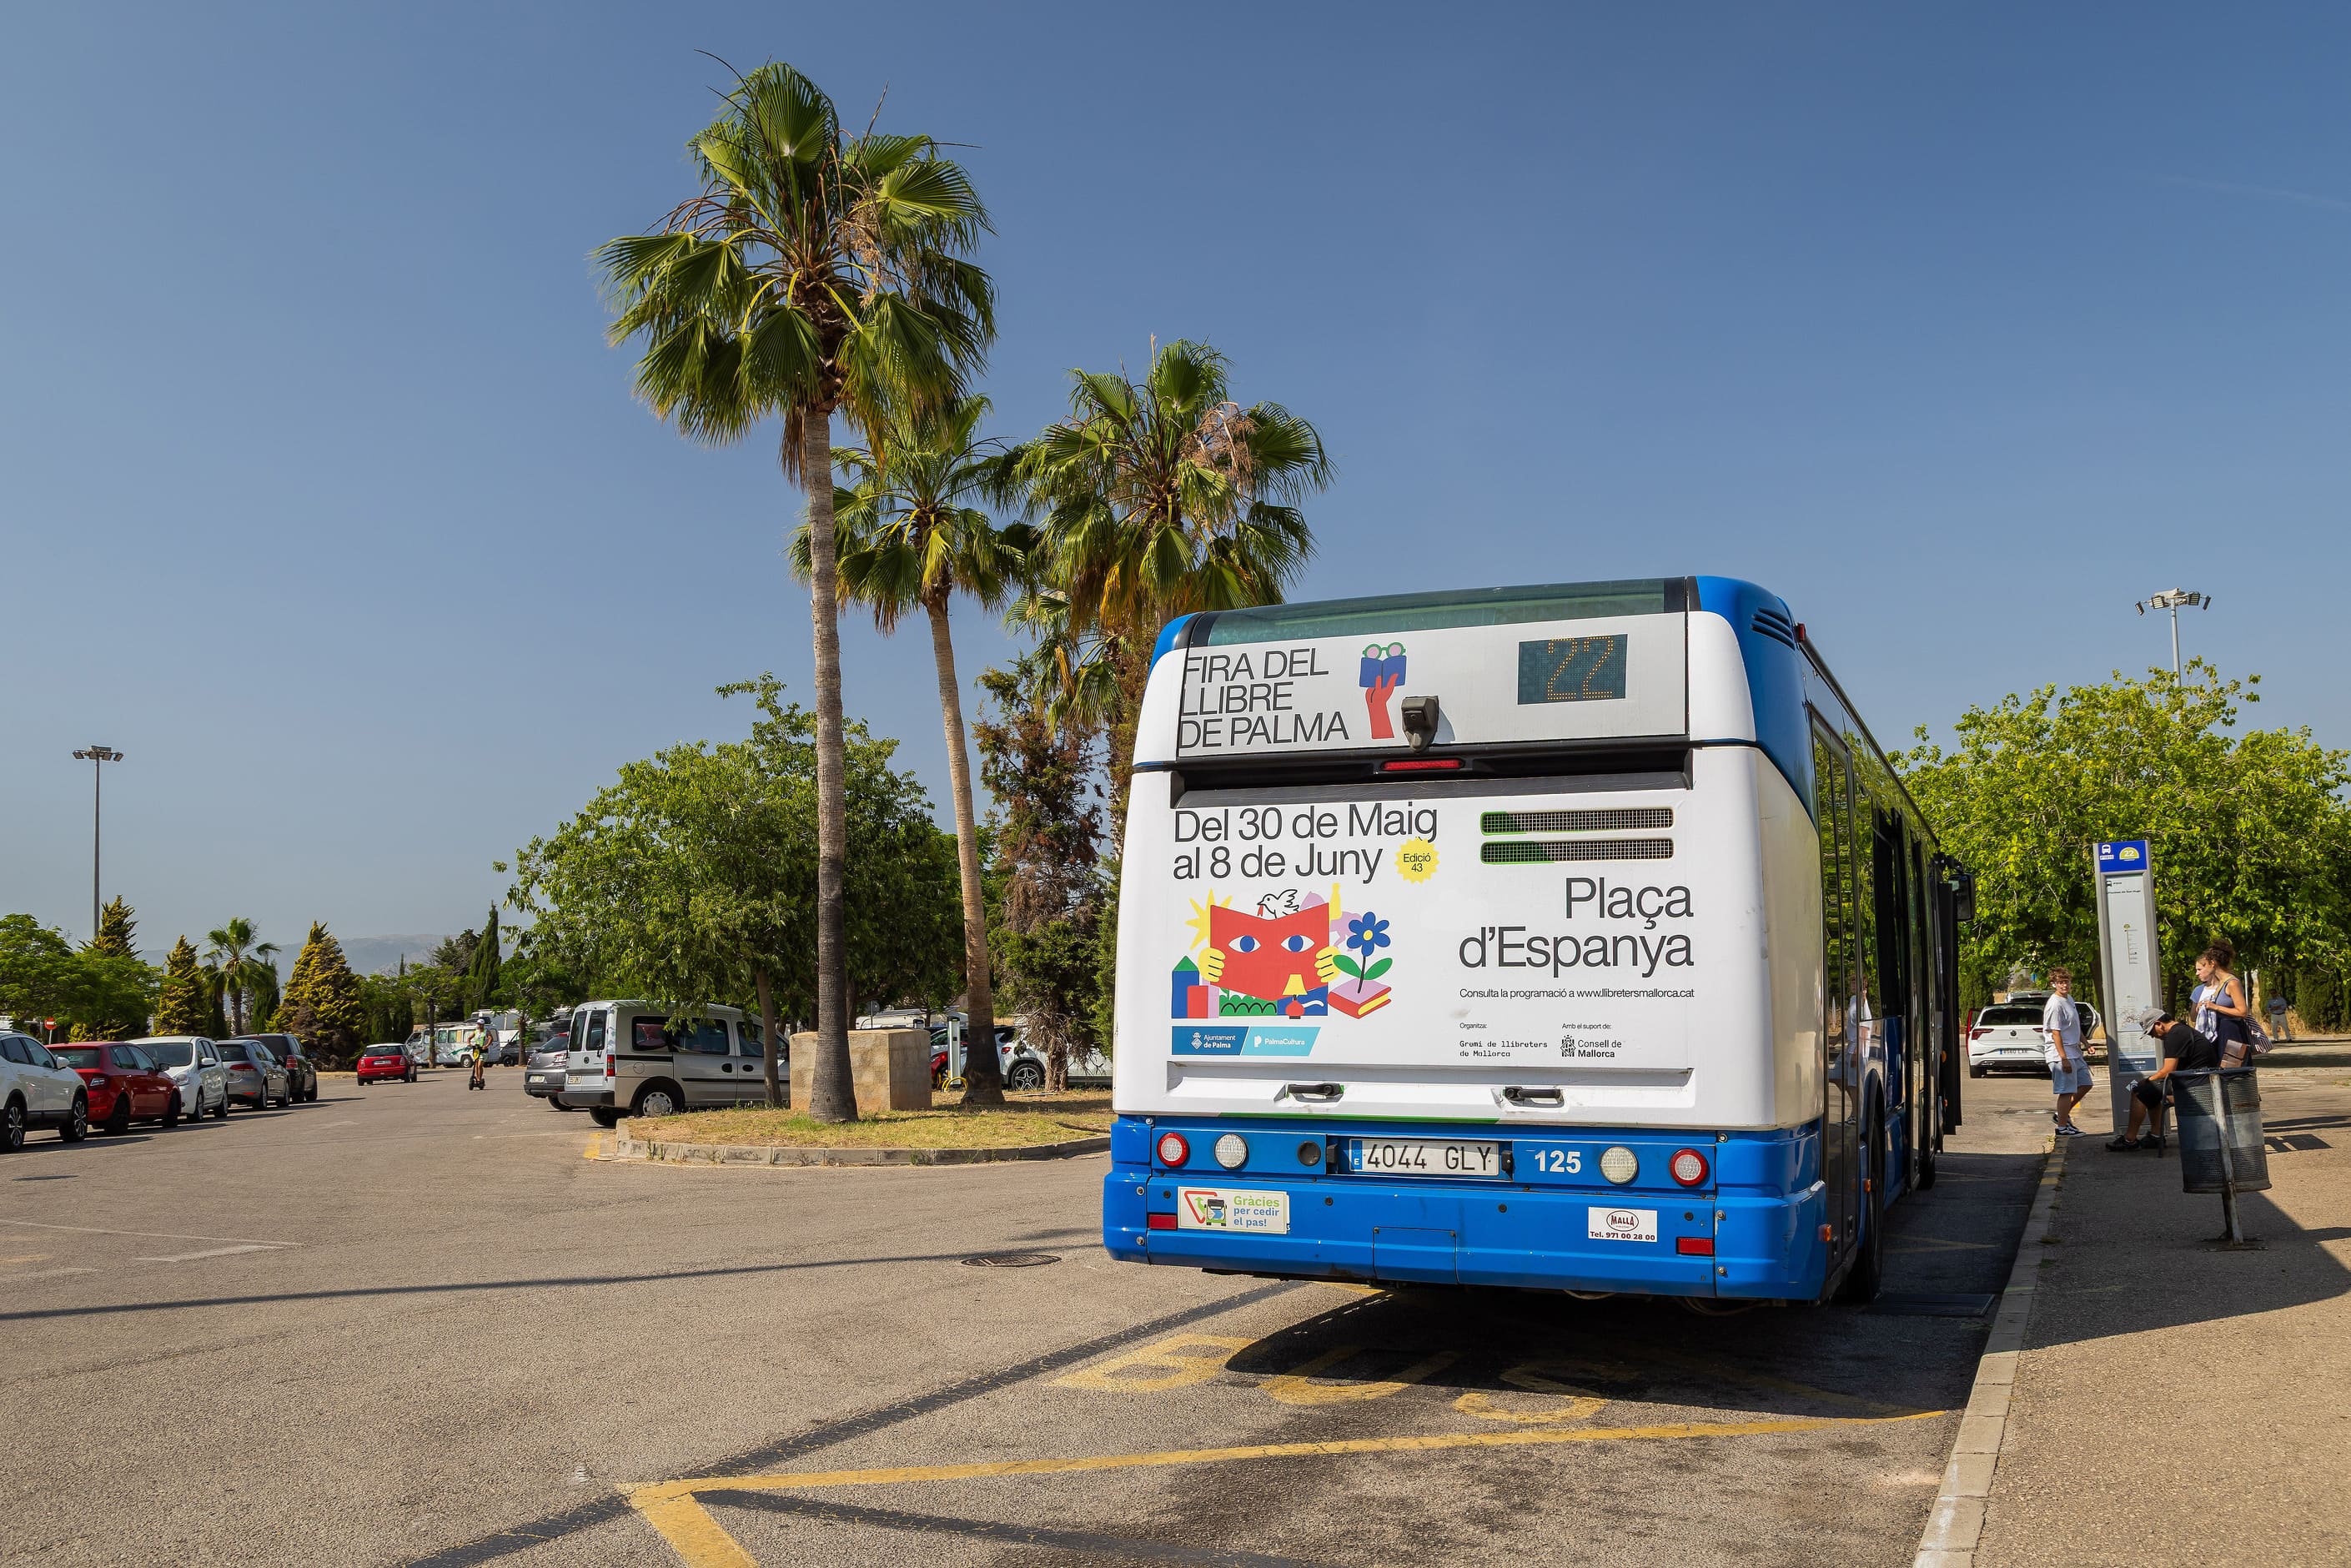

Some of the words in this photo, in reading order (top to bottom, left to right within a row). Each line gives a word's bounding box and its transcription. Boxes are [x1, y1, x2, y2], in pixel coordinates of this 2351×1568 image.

[1186, 653, 1254, 683] FIRA
[1263, 648, 1329, 679] DEL
[1548, 636, 1613, 700] 22
[1181, 681, 1294, 716] LLIBRE
[1178, 718, 1222, 748] DE
[1230, 711, 1349, 746] PALMA
[1174, 808, 1229, 842] Del
[1238, 807, 1283, 841] 30
[1292, 805, 1338, 839] de
[1349, 801, 1437, 843] Maig
[1173, 847, 1200, 880] al
[1209, 846, 1231, 878] 8
[1240, 845, 1286, 877] de
[1295, 843, 1383, 884] Juny
[1403, 852, 1431, 863] Edició
[1411, 862, 1423, 872] 43
[1565, 877, 1694, 930] Plaça
[1459, 926, 1694, 977] d'Espanya
[1459, 988, 1500, 998] Consulta
[1501, 988, 1509, 998] la
[1510, 988, 1567, 1000] programació
[1576, 988, 1695, 998] www.llibretersmallorca.cat
[1203, 1034, 1236, 1043] Ajuntament
[1578, 1040, 1609, 1048] Consell
[1611, 1040, 1622, 1048] de
[1578, 1049, 1615, 1058] Mallorca
[1368, 1143, 1427, 1169] 4044
[1445, 1146, 1491, 1171] GLY
[1535, 1149, 1581, 1173] 125
[1233, 1195, 1280, 1208] Gràcies
[1233, 1208, 1250, 1216] per
[1253, 1208, 1279, 1216] cedir
[1610, 1214, 1635, 1227] MALLA
[1233, 1218, 1243, 1226] el
[1246, 1219, 1267, 1228] pas!
